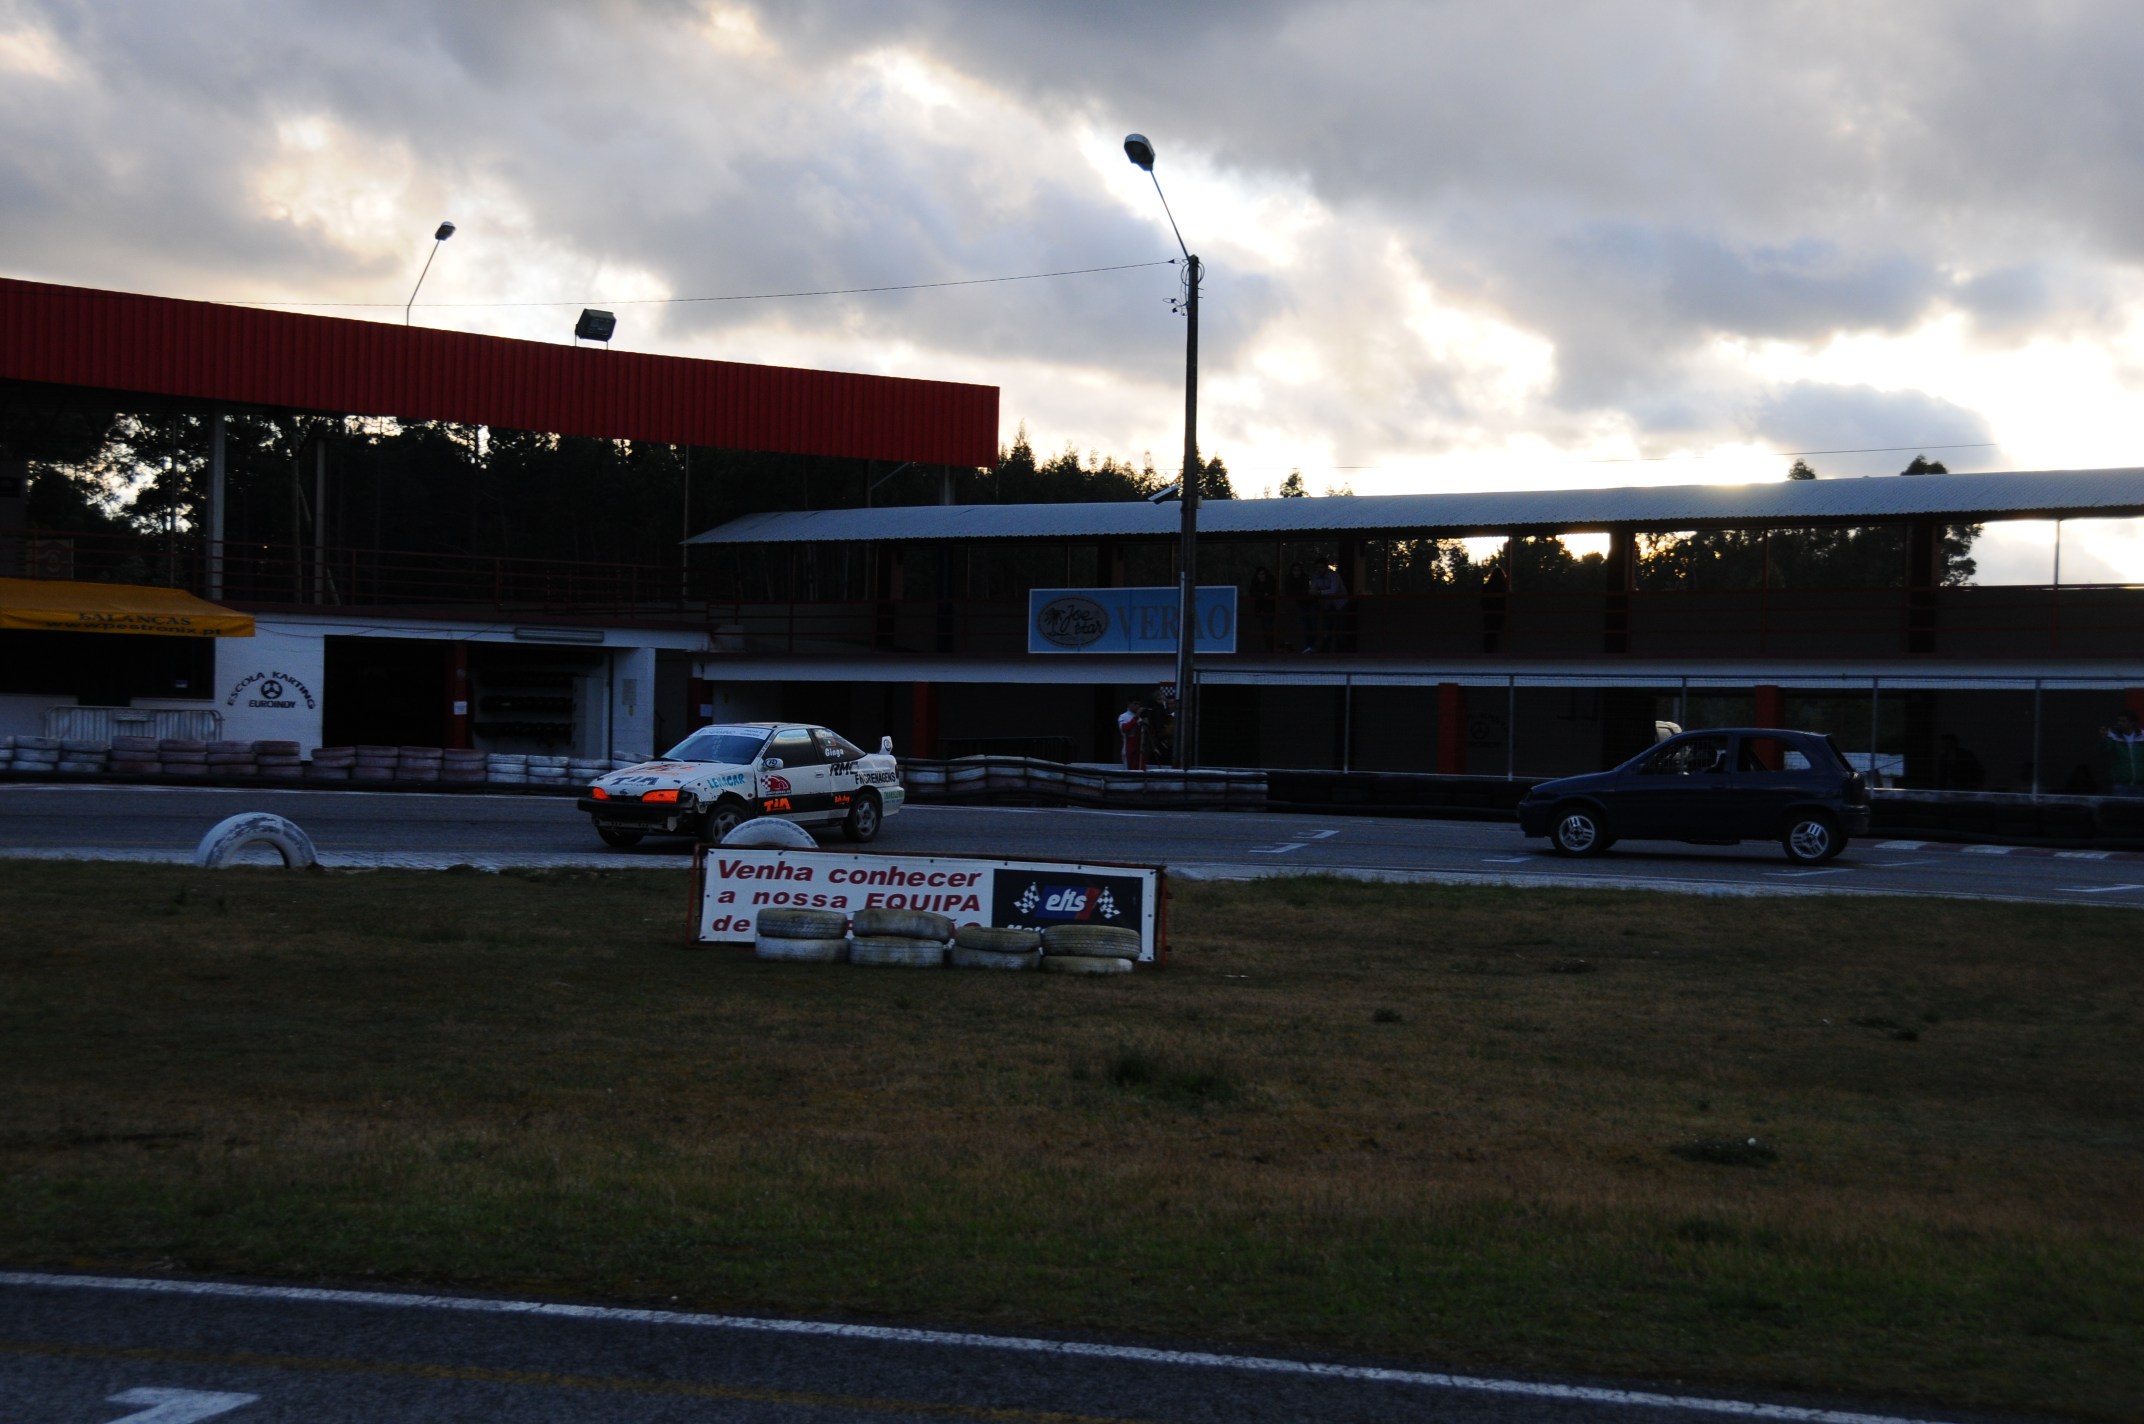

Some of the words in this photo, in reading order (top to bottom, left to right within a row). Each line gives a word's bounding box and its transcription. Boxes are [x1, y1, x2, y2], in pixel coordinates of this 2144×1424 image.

[1060, 604, 1093, 633] Joe
[227, 672, 265, 706] ESCOLA
[272, 671, 315, 710] KARTING
[249, 700, 296, 708] EUROINDY
[718, 859, 813, 882] Venha
[828, 866, 981, 887] conhecer
[717, 891, 735, 904] a
[753, 891, 848, 909] nossa
[864, 892, 980, 912] EQUIPA
[712, 915, 751, 932] de
